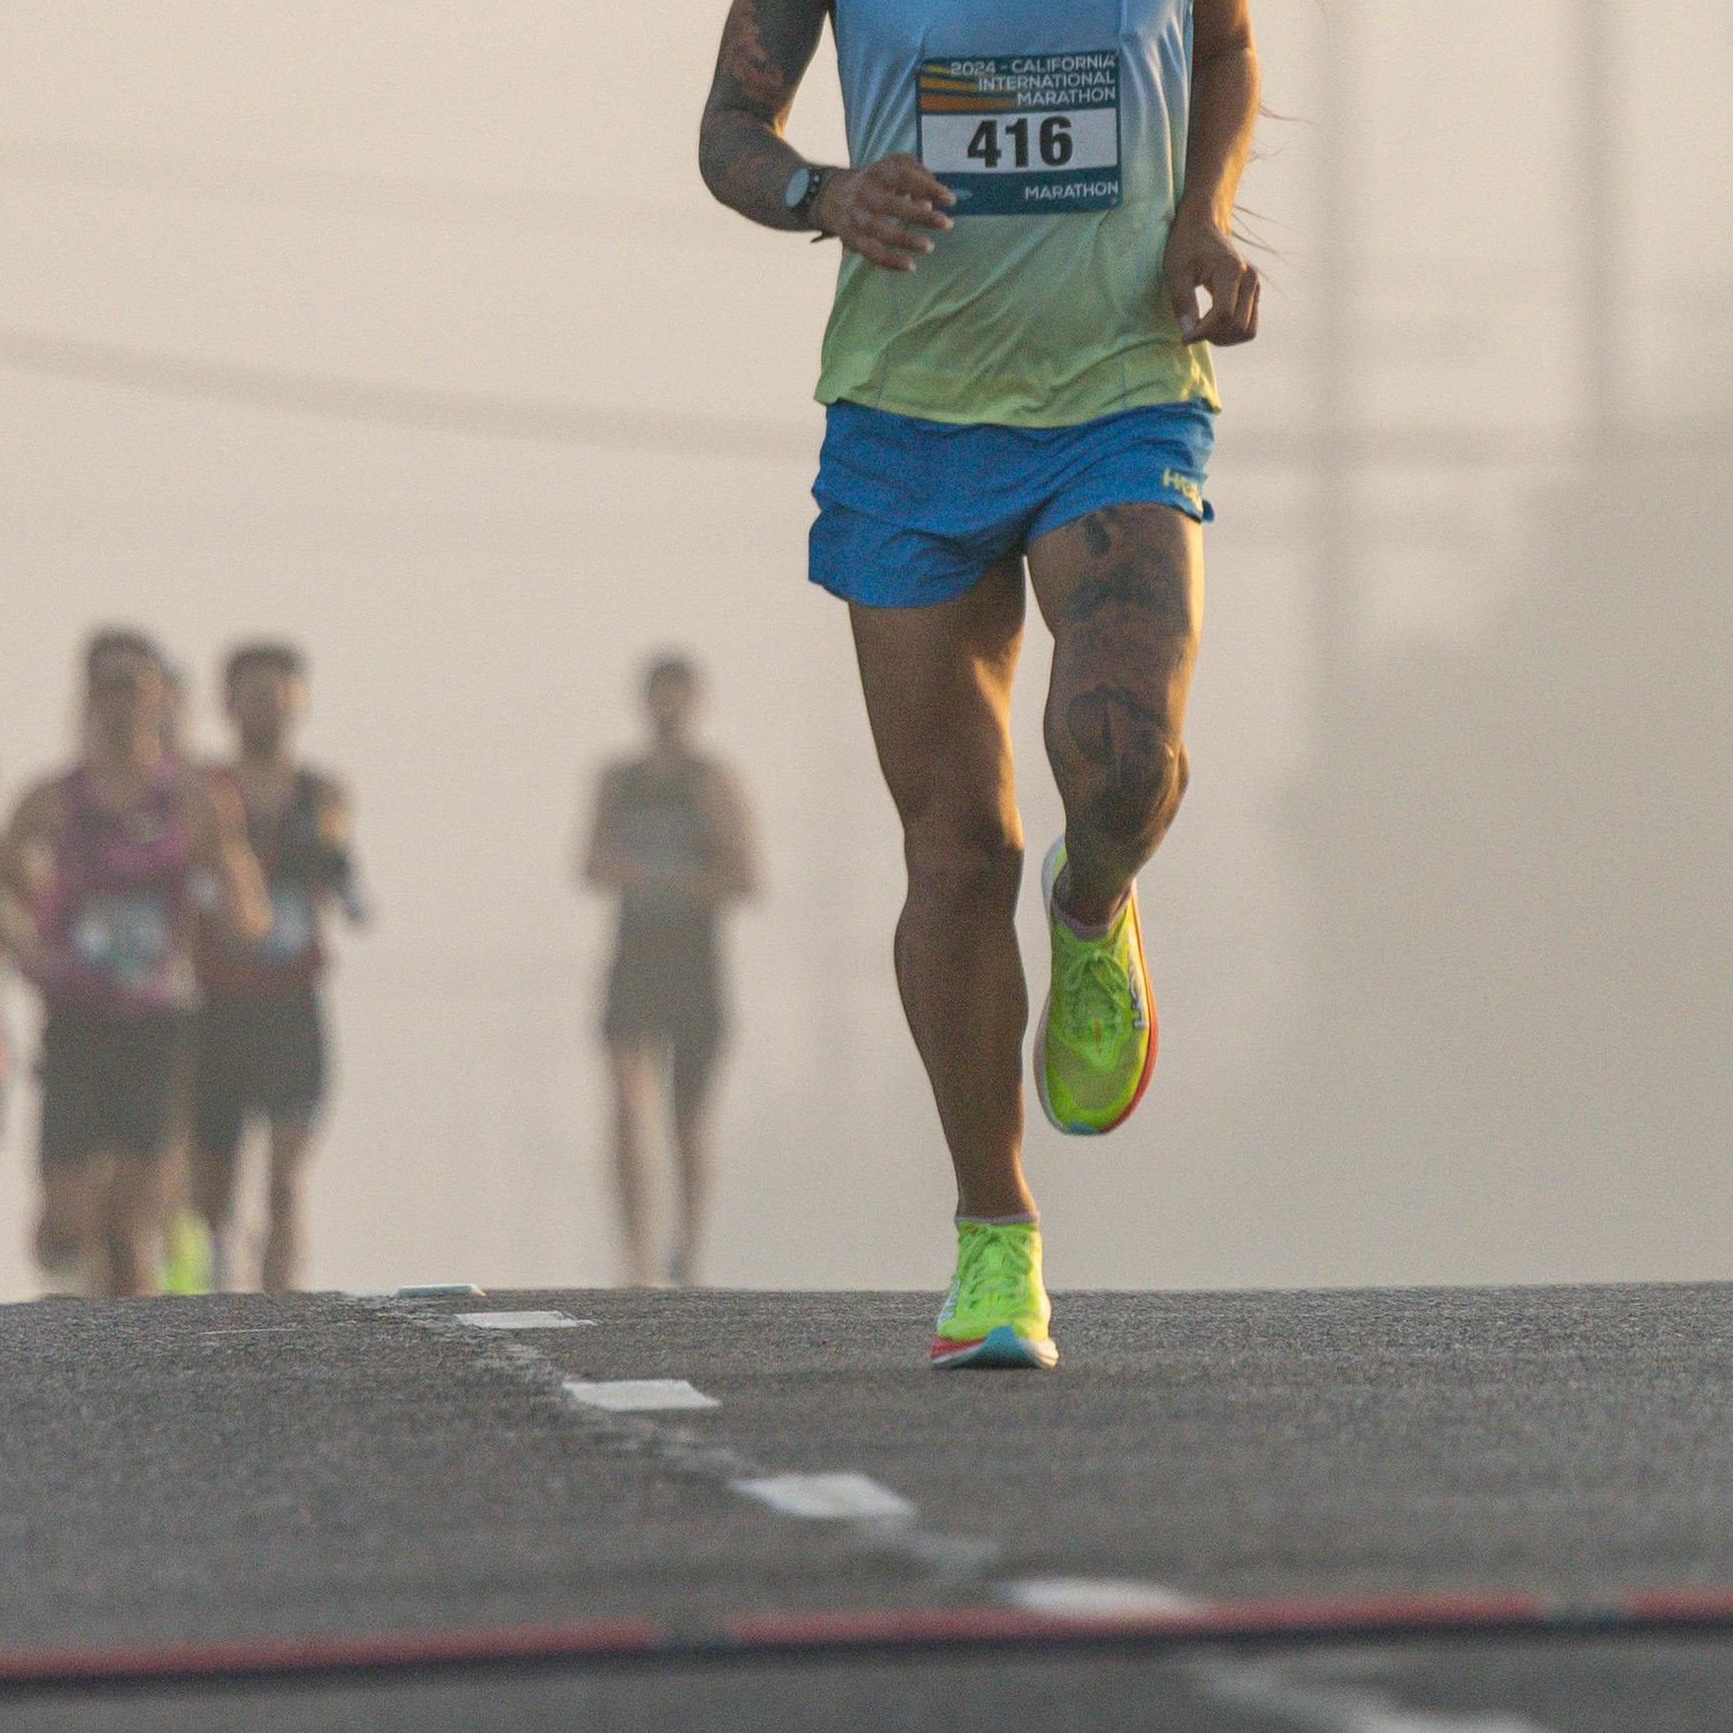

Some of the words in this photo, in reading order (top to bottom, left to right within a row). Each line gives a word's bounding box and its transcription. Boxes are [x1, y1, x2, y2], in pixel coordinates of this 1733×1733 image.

[950, 61, 997, 76] 2024
[1012, 53, 1116, 73] CALIFORNIA
[978, 71, 1115, 91] INTERNATIONAL
[1017, 87, 1116, 106] MARATHON
[967, 116, 1073, 168] 416
[1025, 181, 1118, 201] MARATHON
